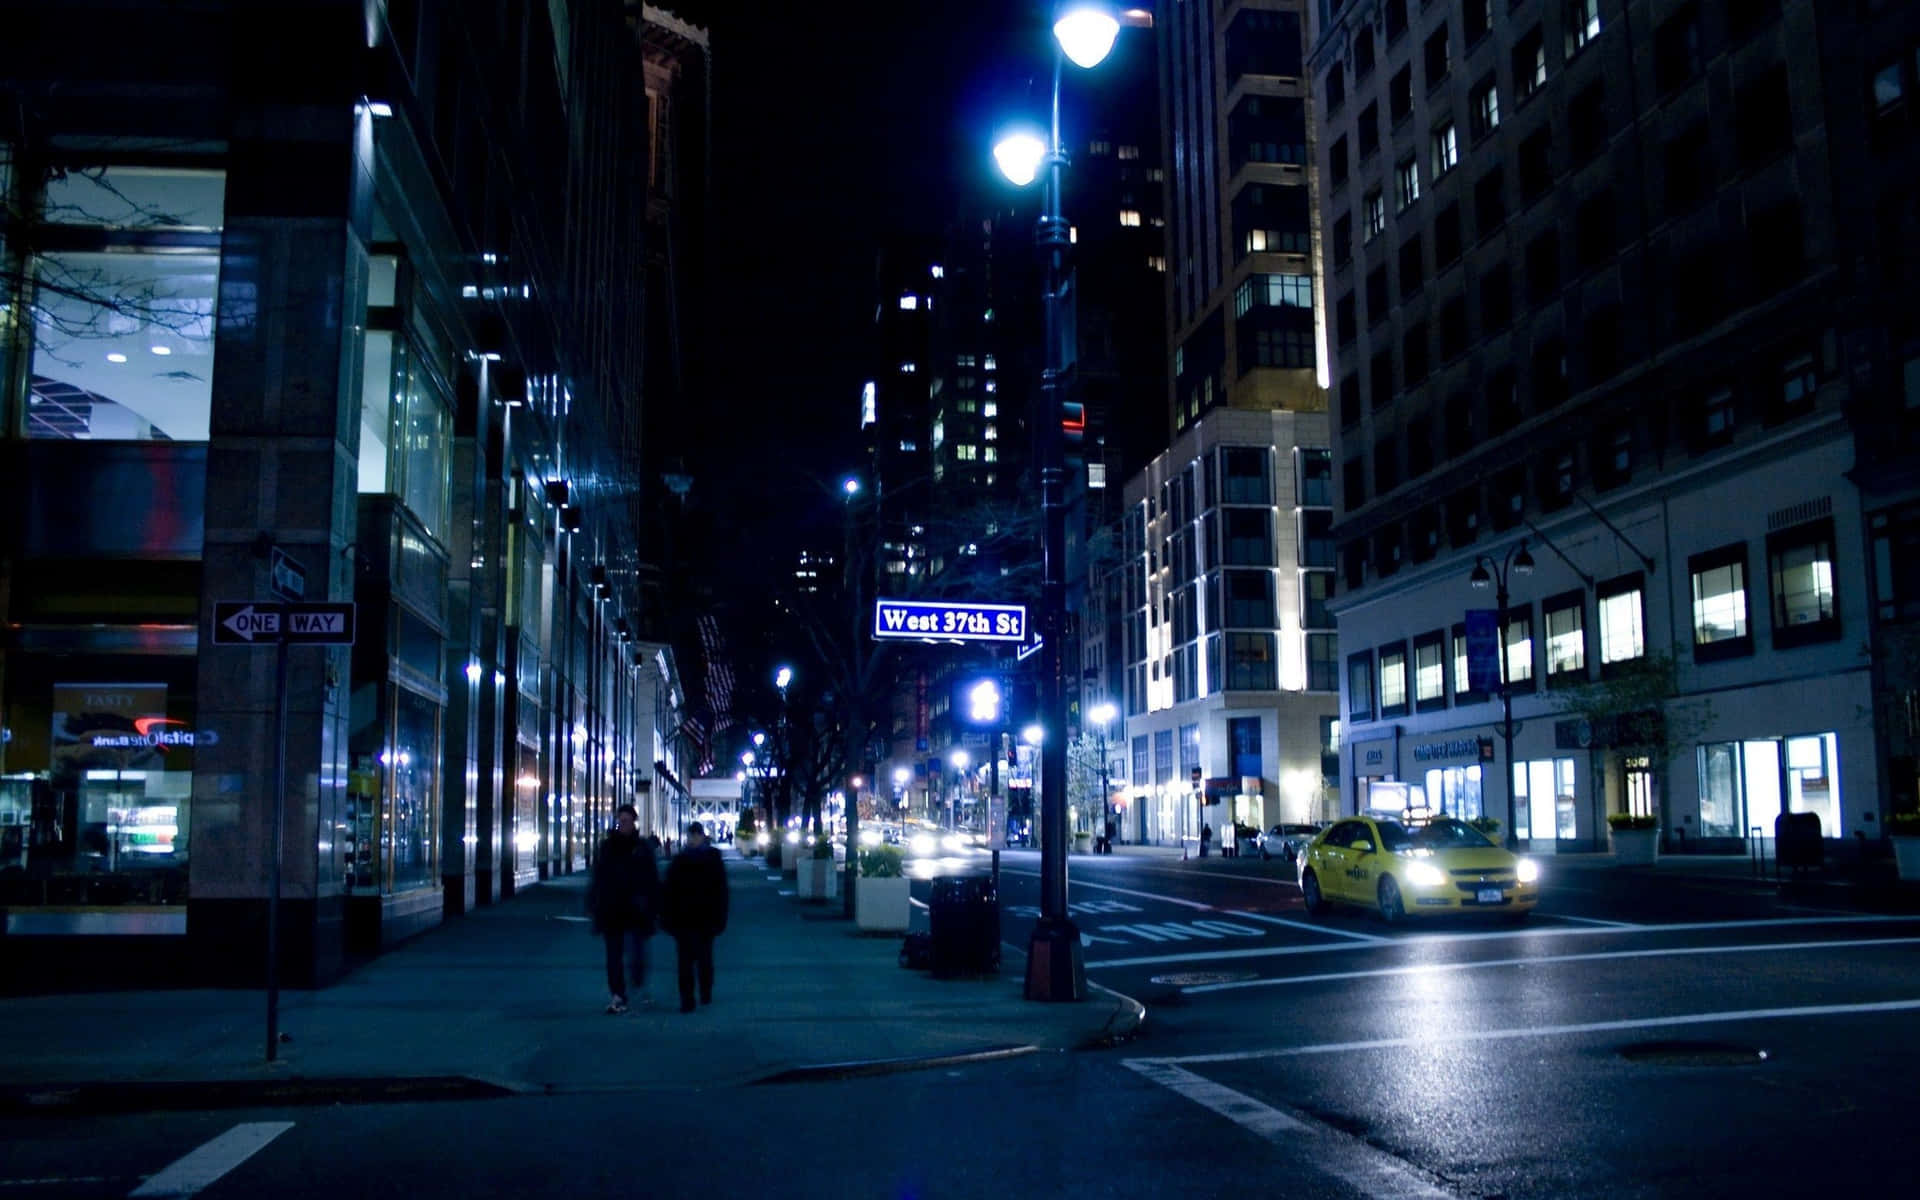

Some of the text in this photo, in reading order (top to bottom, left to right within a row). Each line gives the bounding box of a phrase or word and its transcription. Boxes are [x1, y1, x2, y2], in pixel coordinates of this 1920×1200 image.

[236, 615, 335, 631] ONE WAY
[883, 608, 1019, 634] West 37th St
